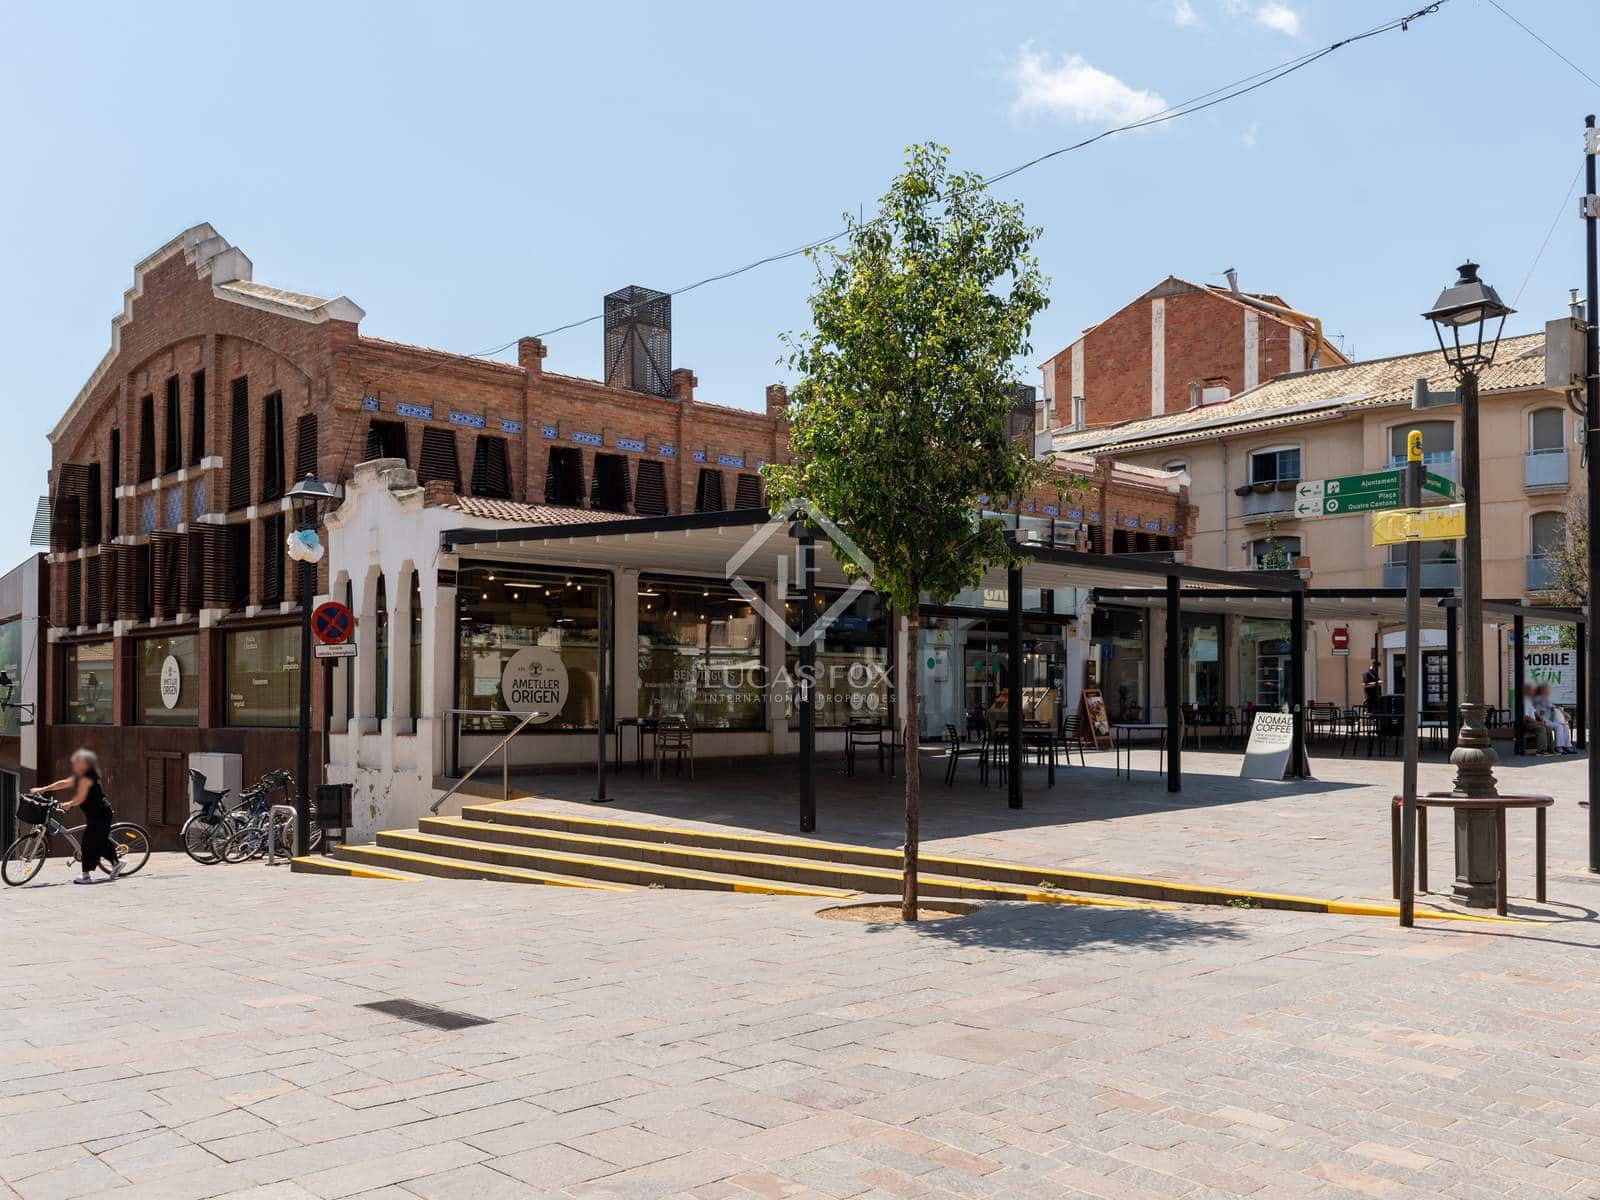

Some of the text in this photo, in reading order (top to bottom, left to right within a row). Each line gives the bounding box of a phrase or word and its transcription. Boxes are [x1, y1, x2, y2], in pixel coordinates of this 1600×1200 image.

[1361, 476, 1397, 487] Ajuntament
[1378, 492, 1397, 500] Plaça
[1523, 653, 1570, 666] MOBILE
[511, 679, 560, 689] AMETLLER
[511, 689, 560, 704] ORIGEN
[1255, 723, 1293, 733] COFFEE
